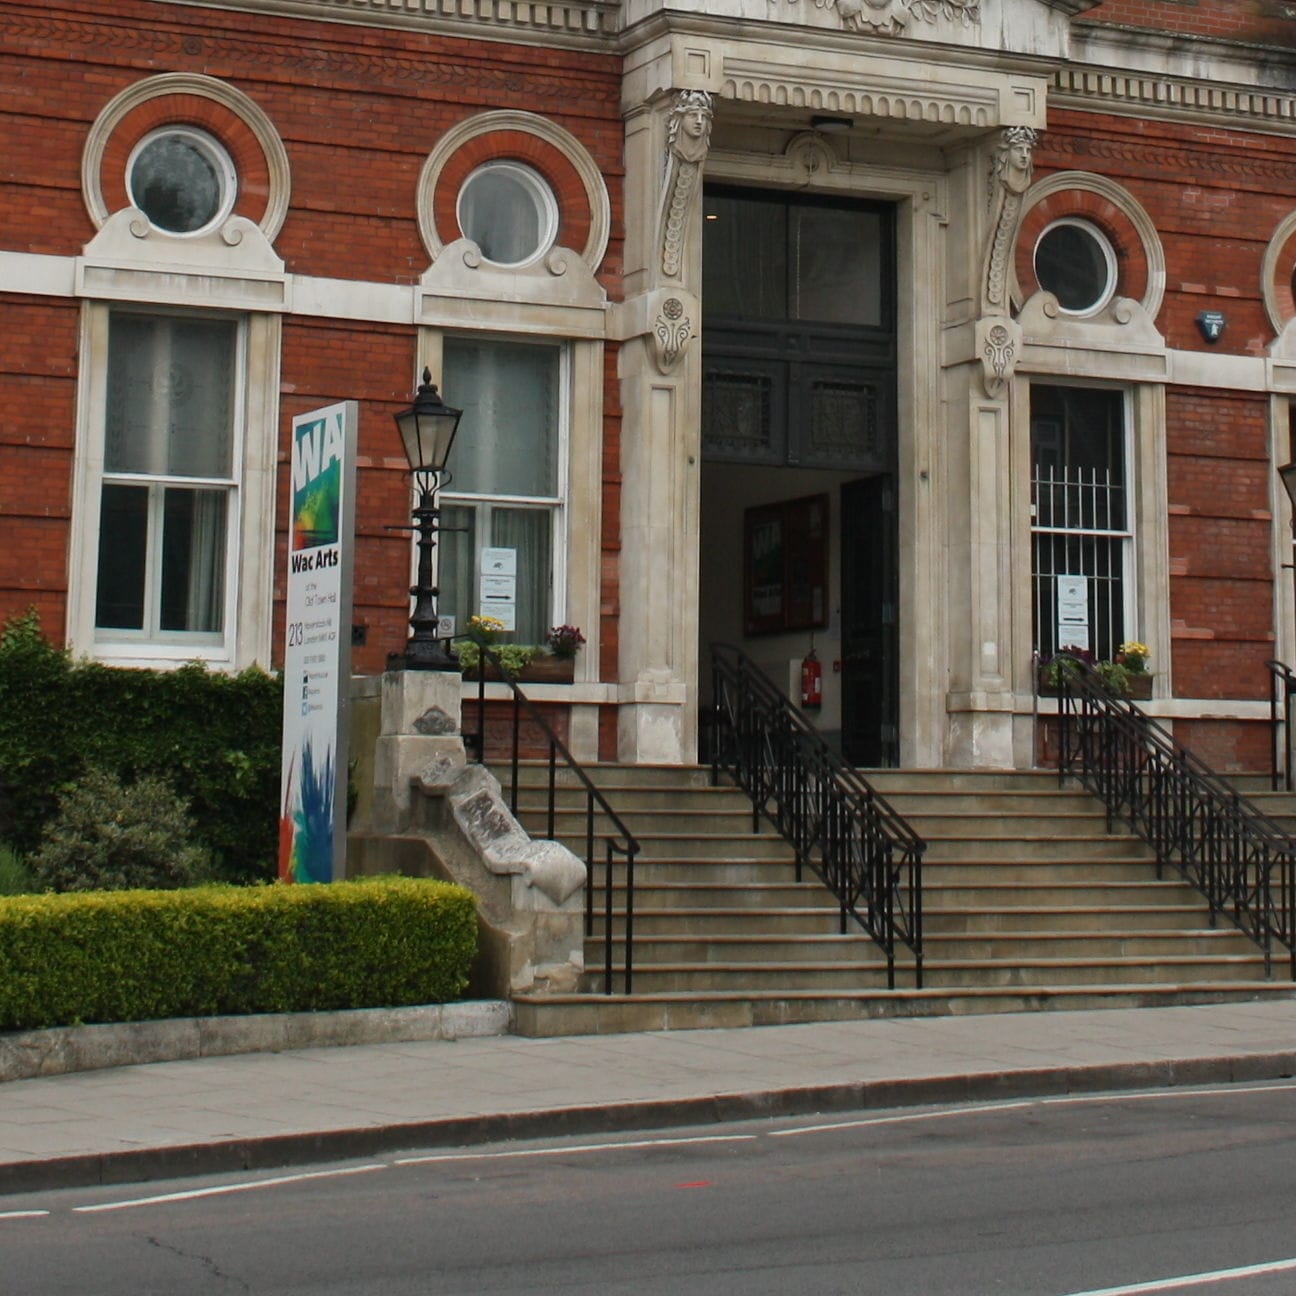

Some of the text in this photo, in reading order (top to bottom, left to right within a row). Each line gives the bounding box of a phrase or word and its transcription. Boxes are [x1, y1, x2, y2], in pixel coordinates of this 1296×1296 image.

[294, 414, 342, 492] WA
[292, 549, 338, 574] Wac Arts
[289, 622, 303, 647] 213
